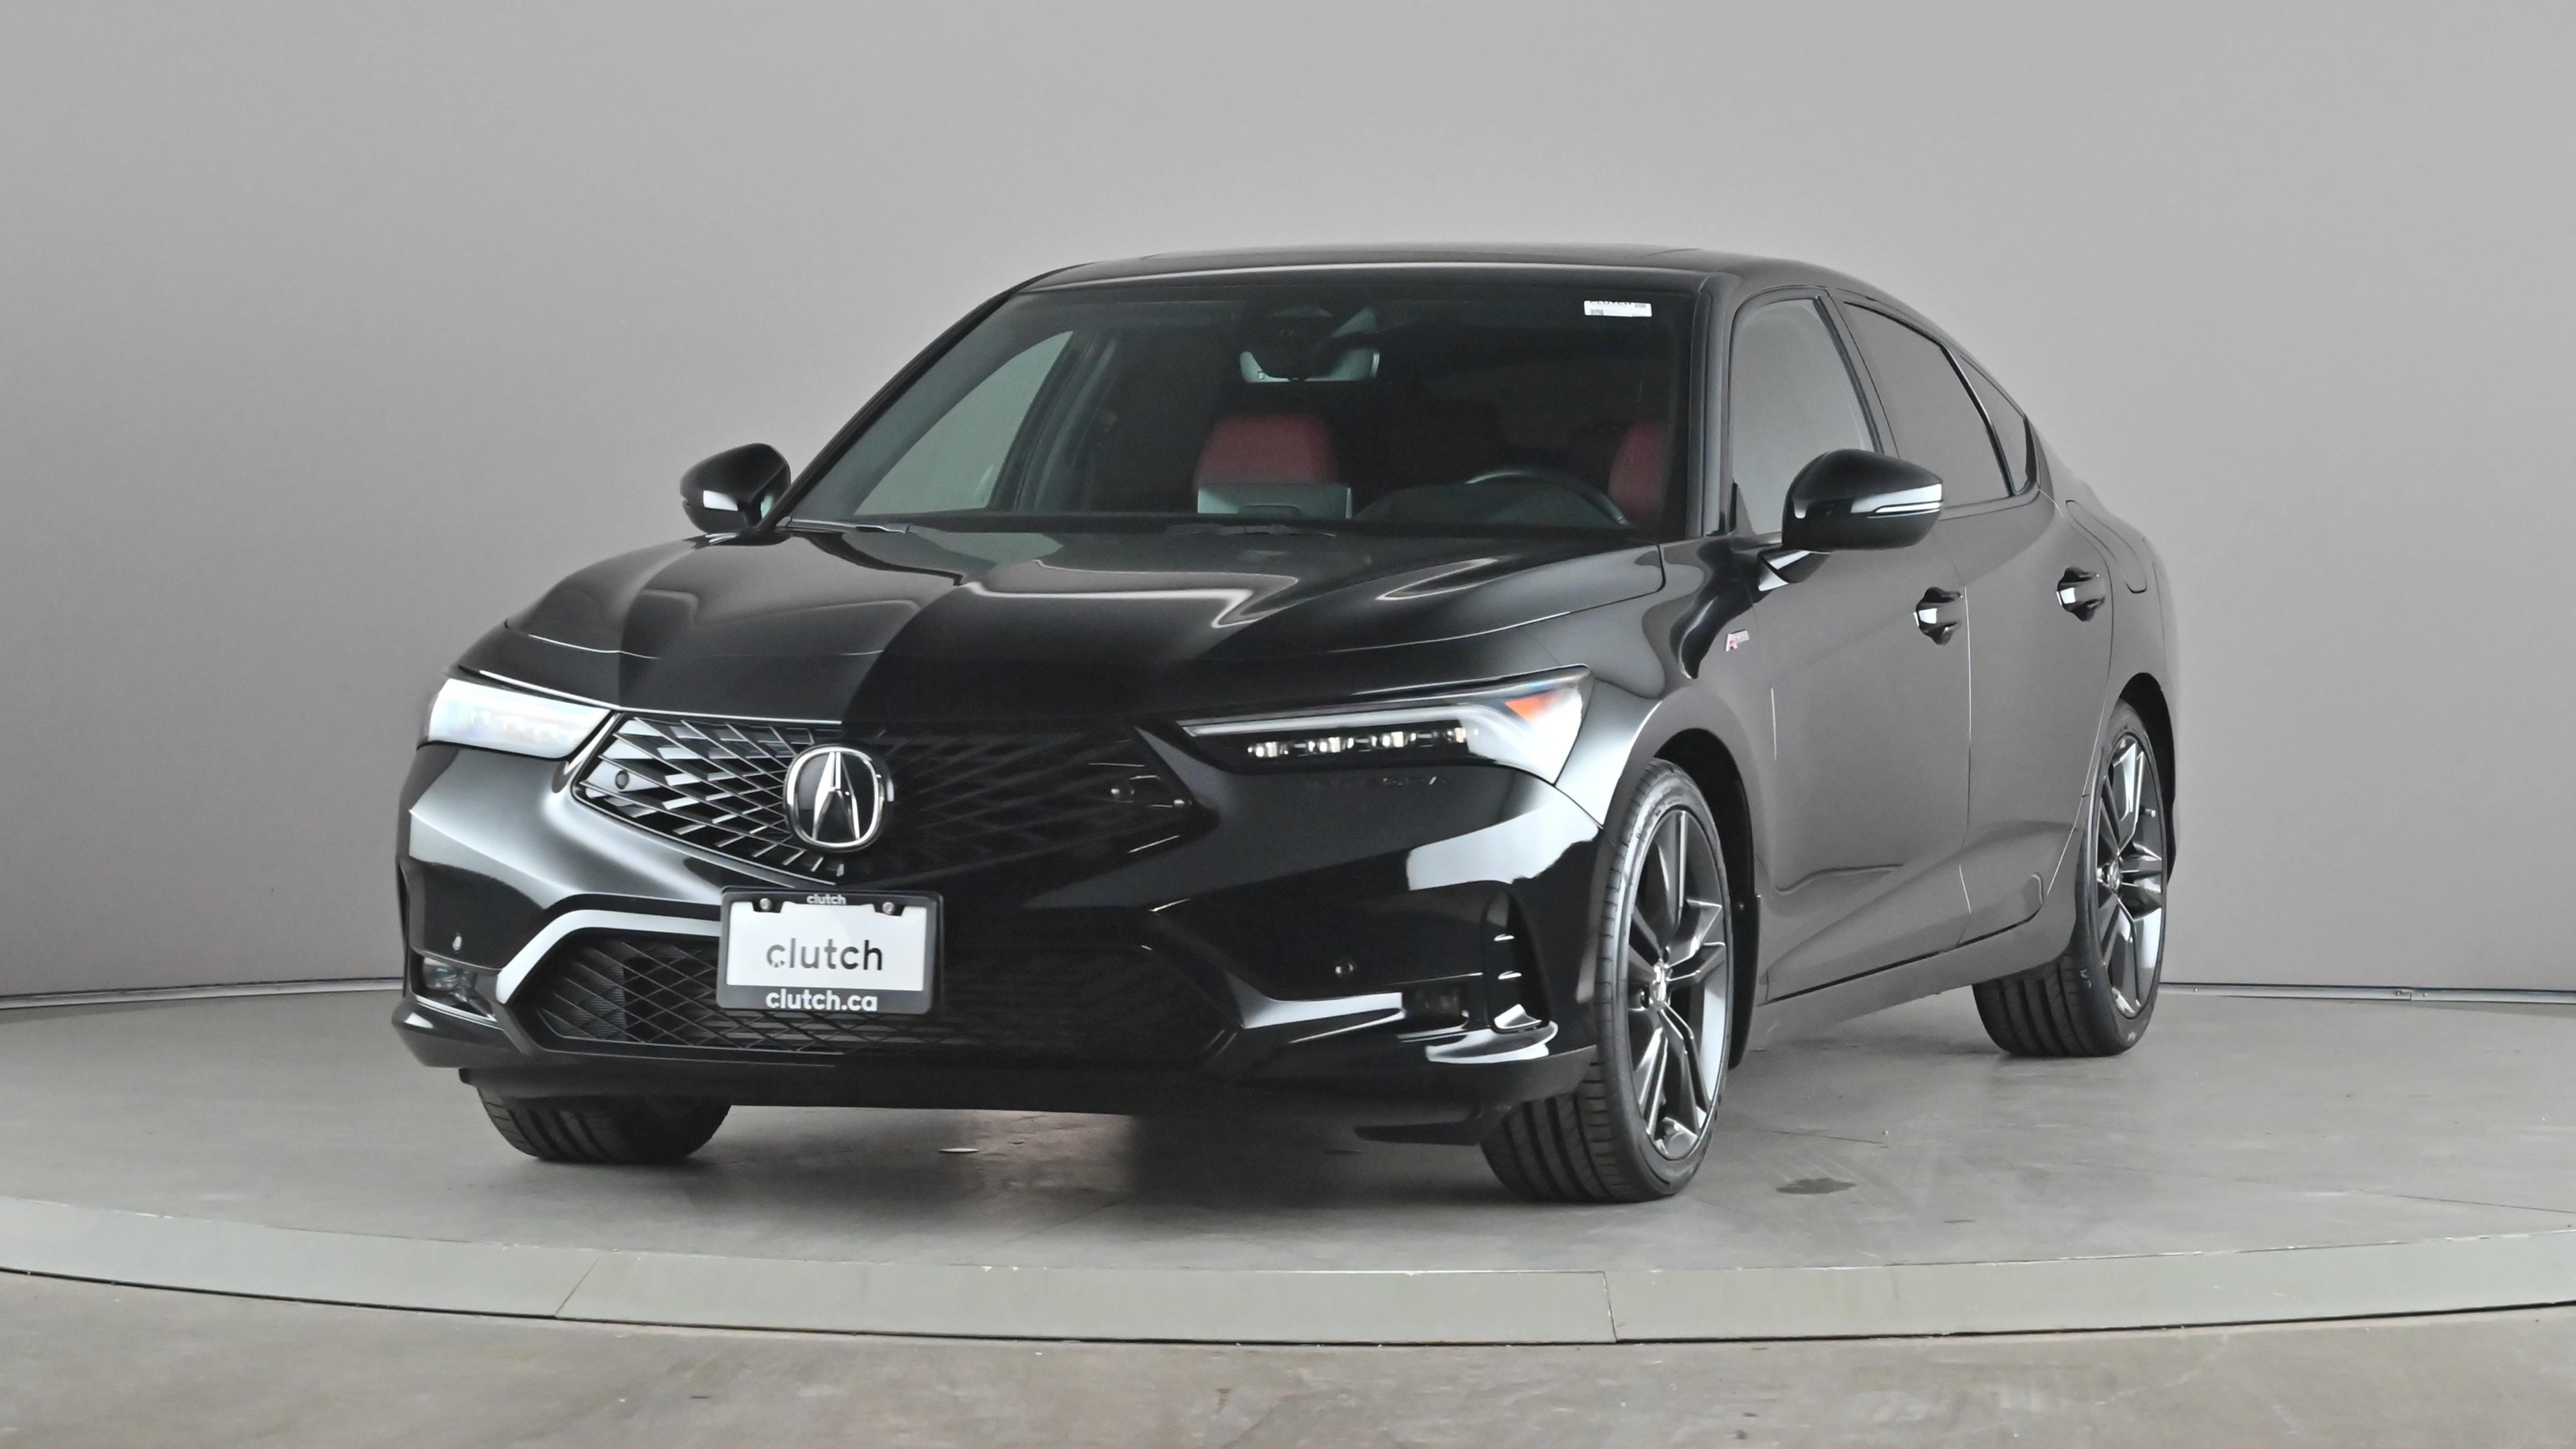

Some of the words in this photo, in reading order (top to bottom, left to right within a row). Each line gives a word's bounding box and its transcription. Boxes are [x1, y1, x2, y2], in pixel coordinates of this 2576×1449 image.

[806, 894, 846, 905] clutch
[766, 938, 883, 971] clutch
[766, 989, 878, 1011] clutch.ca
